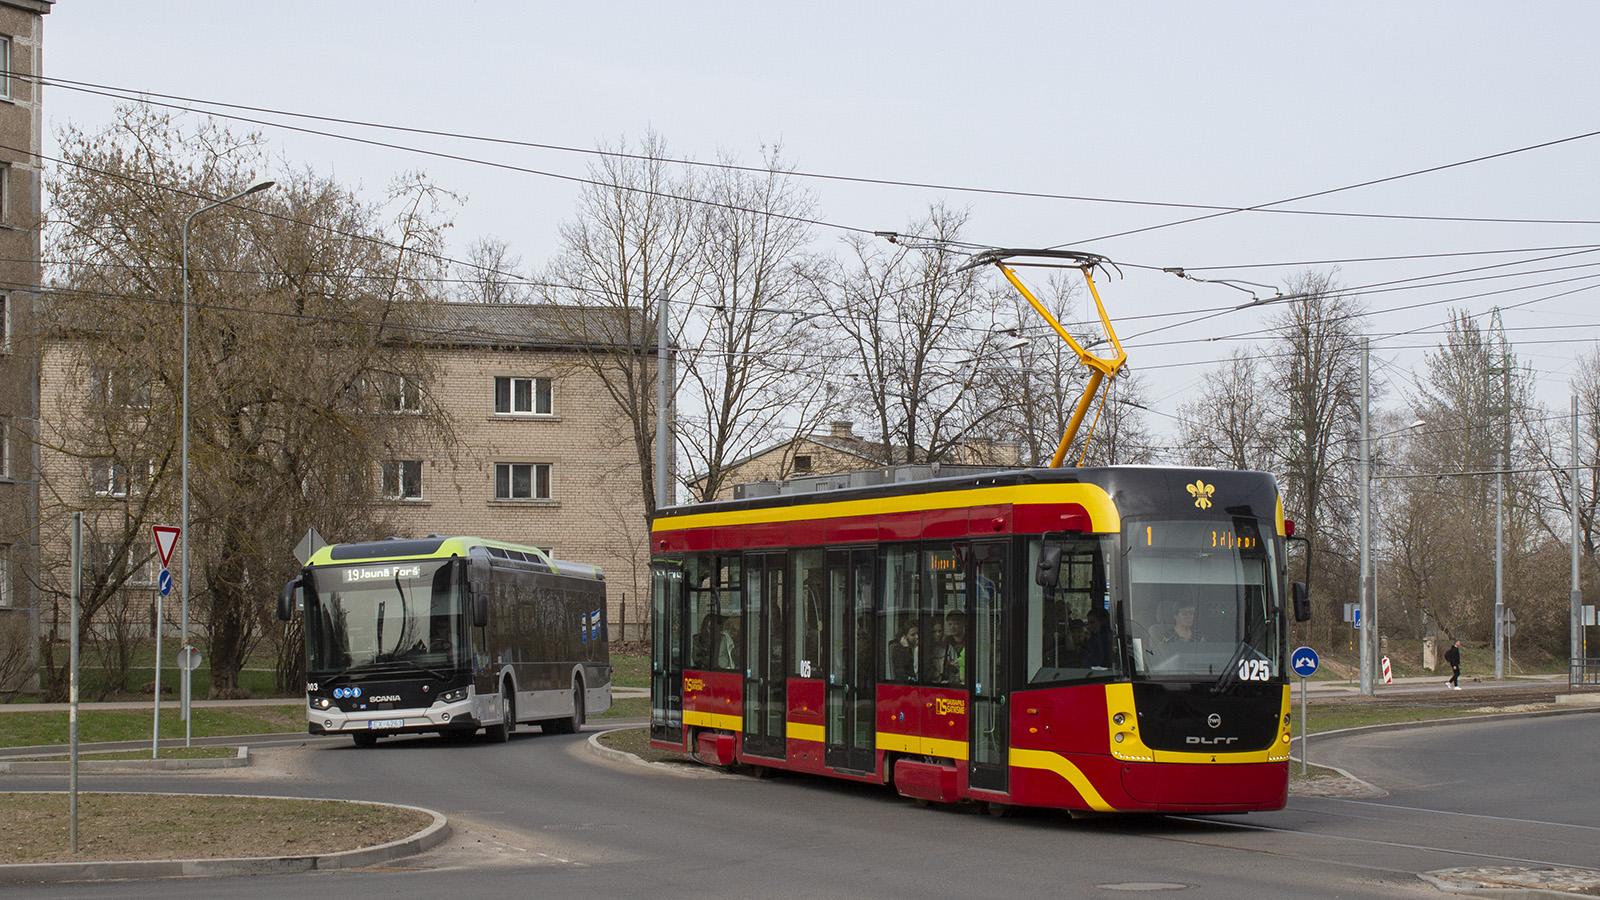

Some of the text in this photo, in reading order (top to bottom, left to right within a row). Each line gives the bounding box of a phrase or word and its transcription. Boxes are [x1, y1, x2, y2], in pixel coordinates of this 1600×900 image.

[1146, 526, 1152, 546] 1
[347, 569, 359, 581] 19
[801, 660, 811, 678] 025
[1238, 659, 1270, 682] 025
[369, 695, 401, 703] SCANIA
[936, 698, 947, 716] DS
